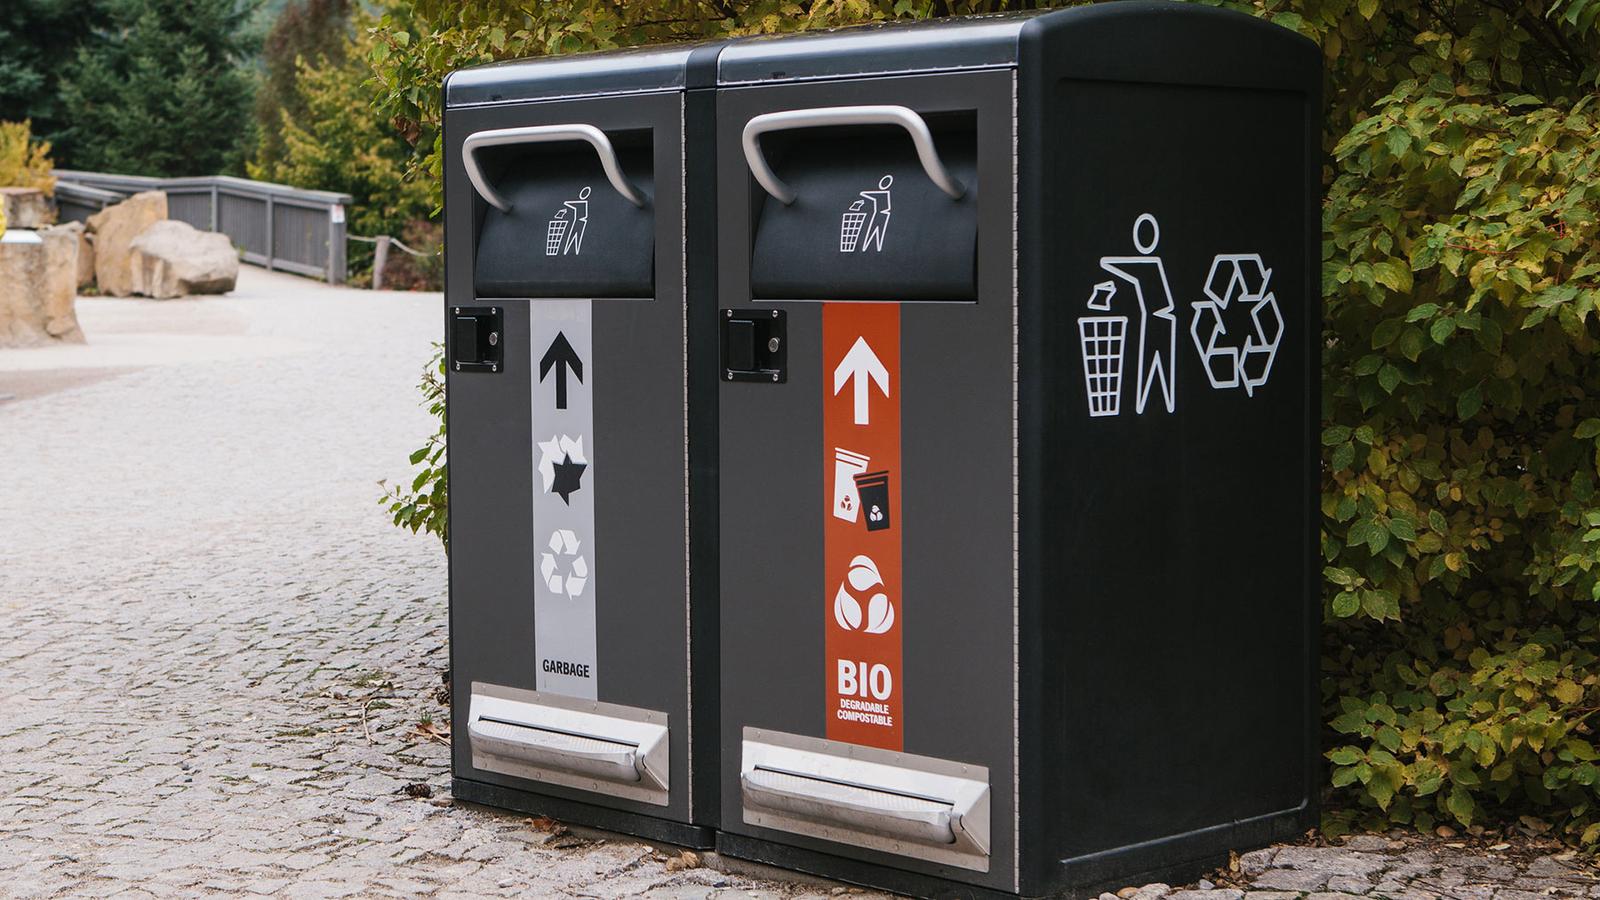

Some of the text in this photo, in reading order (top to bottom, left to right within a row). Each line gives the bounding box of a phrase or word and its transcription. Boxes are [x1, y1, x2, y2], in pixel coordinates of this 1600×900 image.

[542, 659, 590, 678] GARBAGE
[837, 658, 892, 701] BIO
[840, 698, 889, 714] DEGRADABLE
[837, 709, 893, 727] COMPOSTABLE
